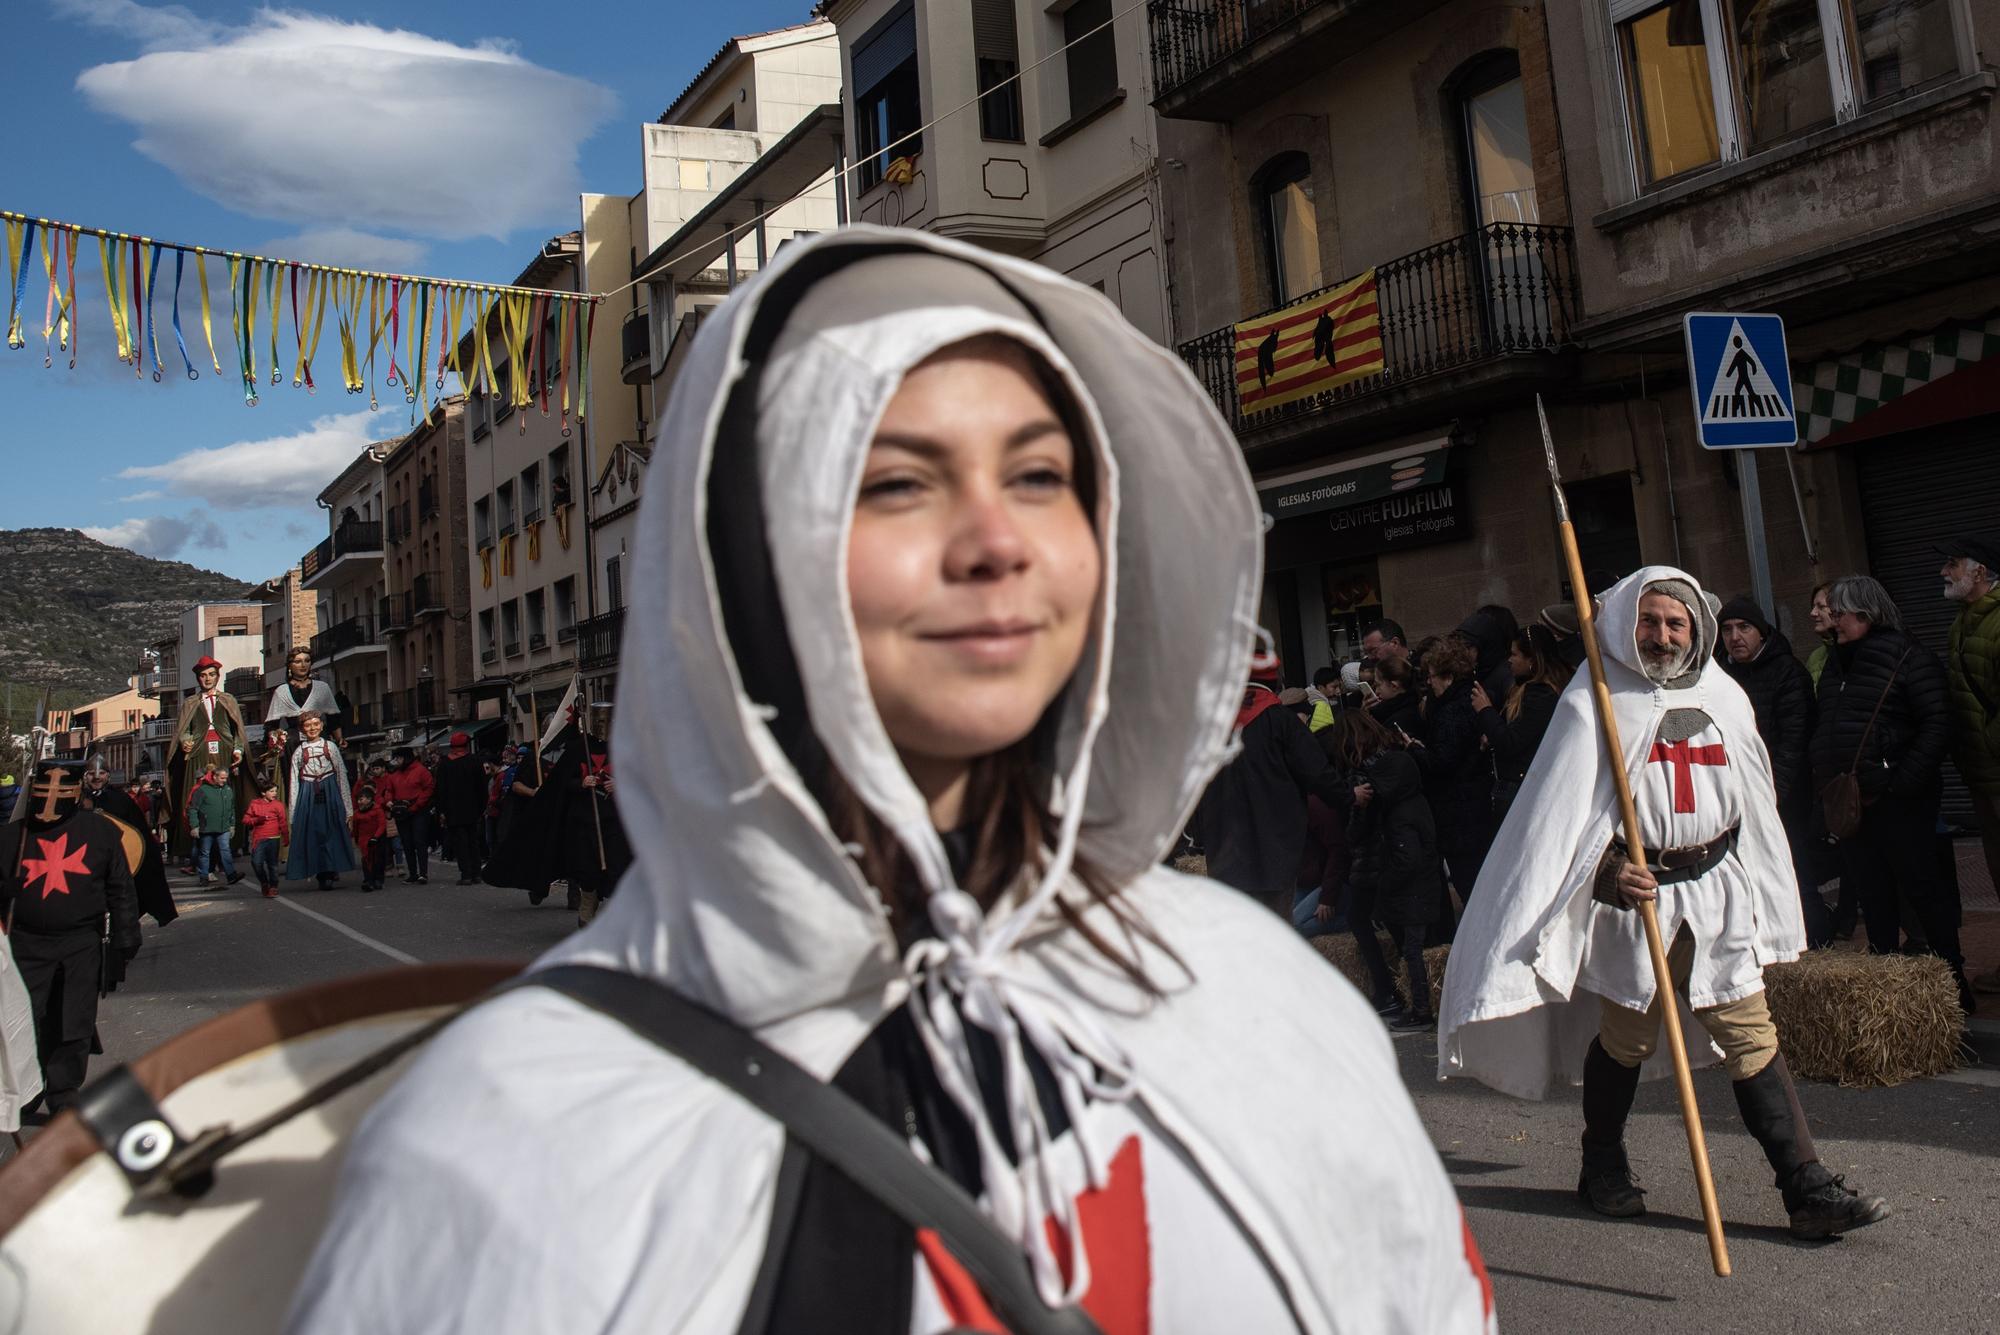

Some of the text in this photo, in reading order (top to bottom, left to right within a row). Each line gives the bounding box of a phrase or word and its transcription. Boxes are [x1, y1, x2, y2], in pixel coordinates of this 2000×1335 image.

[1278, 481, 1356, 507] IGLESIAS FOTÒGRAFS
[1329, 488, 1453, 531] CENTRE FUJIFILM
[1384, 514, 1455, 541] Iglesias Fotògrafs
